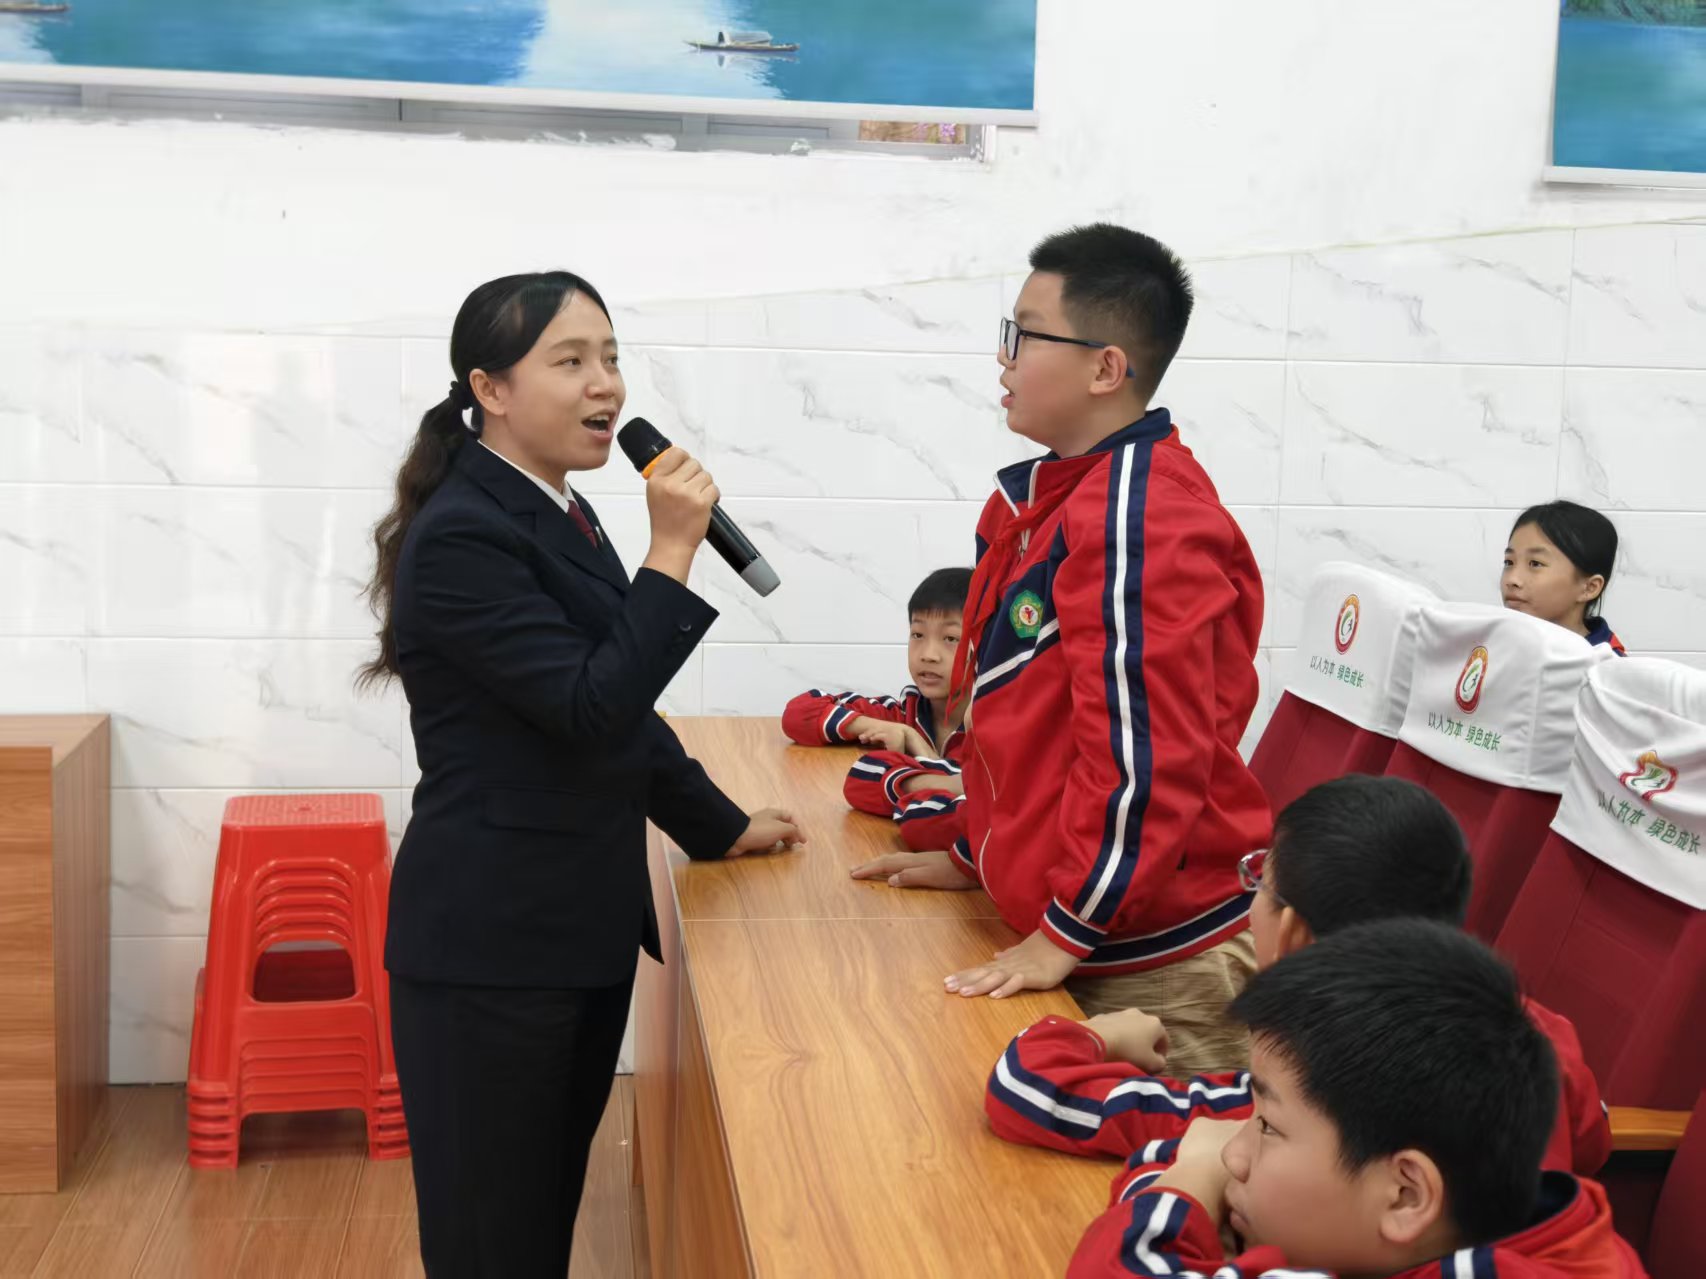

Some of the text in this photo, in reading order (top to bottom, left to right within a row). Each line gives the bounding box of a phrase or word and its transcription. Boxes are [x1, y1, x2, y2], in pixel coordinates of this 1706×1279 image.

[1310, 656, 1364, 687] 以人为本 绿色成长
[1428, 712, 1501, 751] 以人为本 绿色成长
[1646, 817, 1701, 854] 绿色成长
